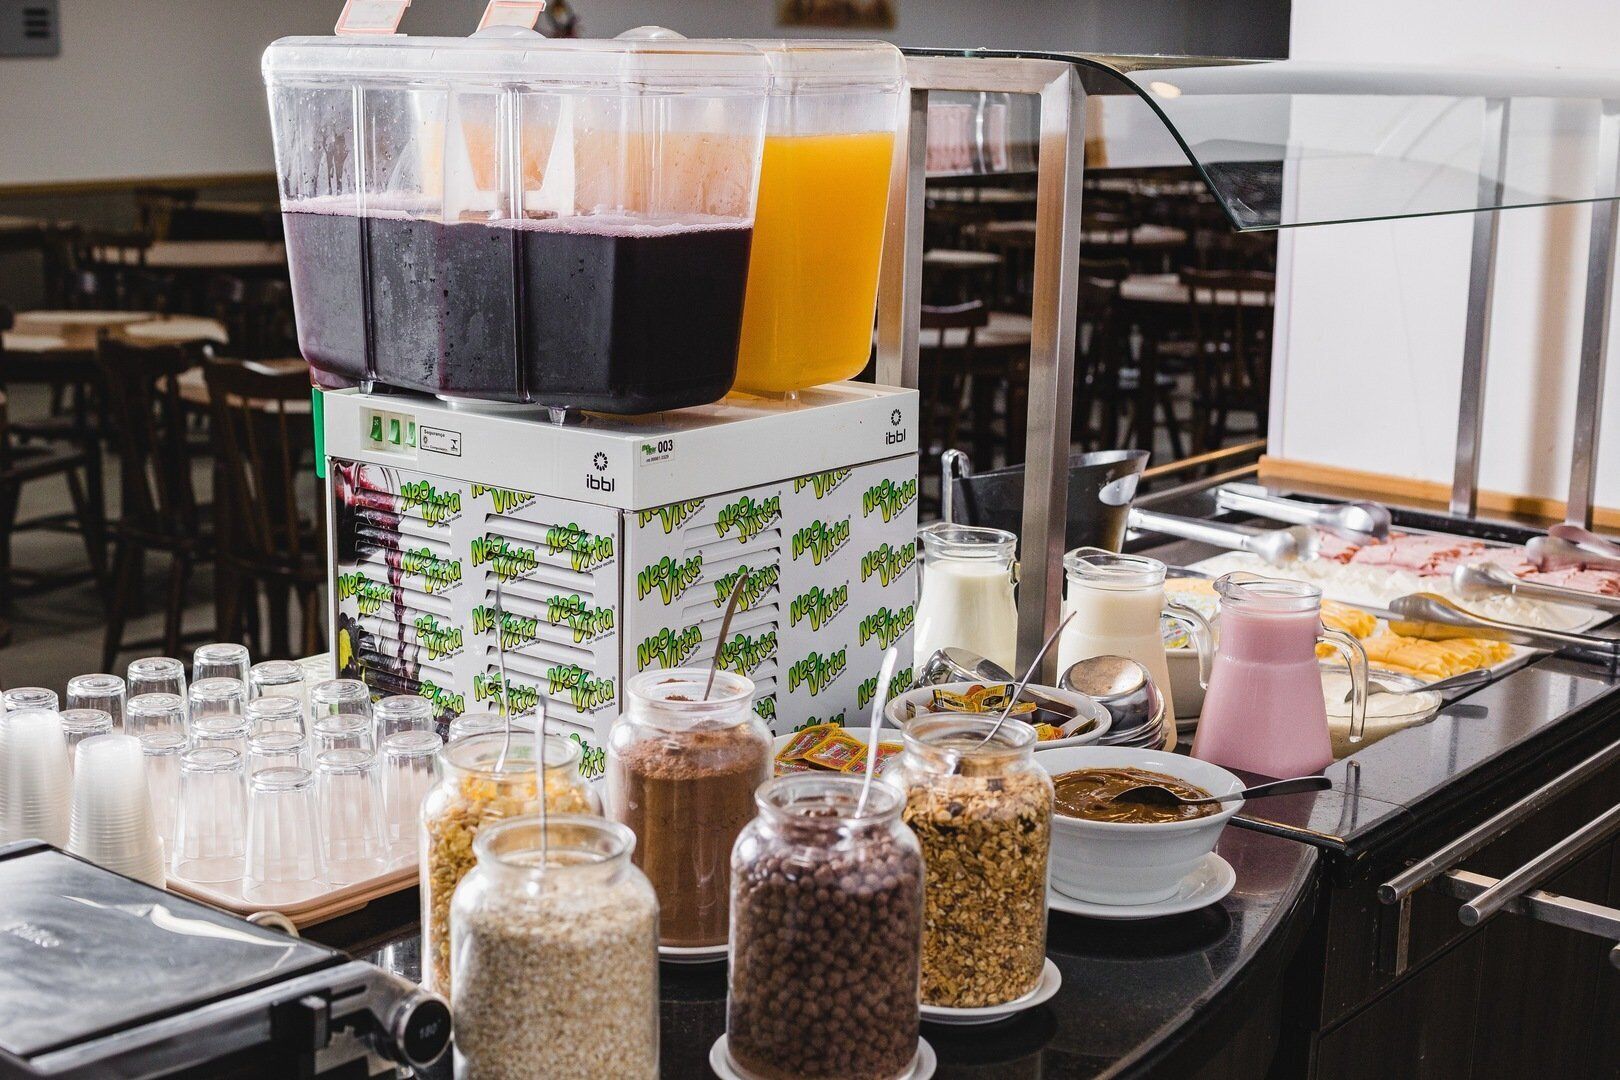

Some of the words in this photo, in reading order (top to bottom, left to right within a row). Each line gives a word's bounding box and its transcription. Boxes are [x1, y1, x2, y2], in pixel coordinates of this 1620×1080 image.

[657, 439, 673, 453] 003
[885, 429, 906, 446] ibbl
[586, 473, 615, 493] ibbl
